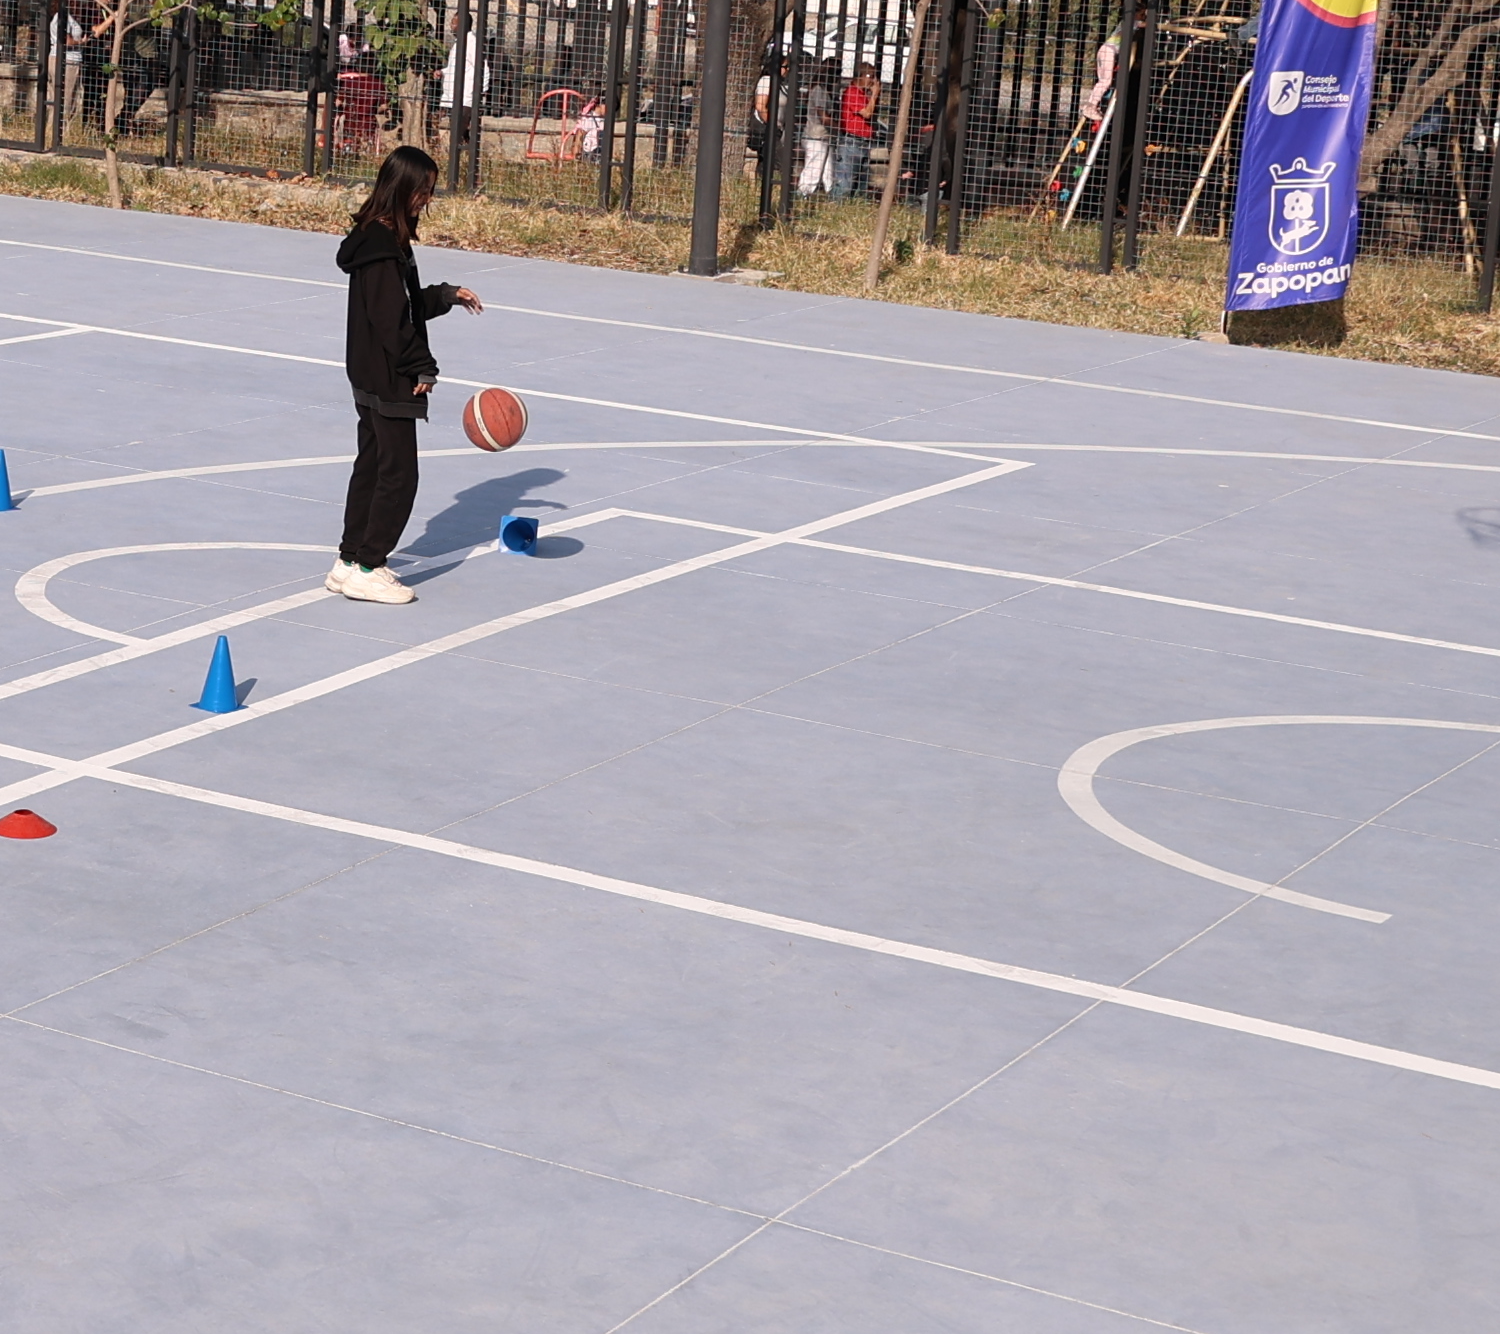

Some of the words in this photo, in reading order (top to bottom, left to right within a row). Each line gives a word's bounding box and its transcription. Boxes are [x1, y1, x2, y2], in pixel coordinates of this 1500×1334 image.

[1305, 75, 1337, 86] Consejo
[1303, 85, 1340, 94] Municipal
[1302, 95, 1314, 103] del
[1315, 94, 1349, 104] Deporte
[1257, 260, 1316, 273] Gobierno
[1318, 257, 1333, 267] de
[1236, 264, 1350, 299] Zapopan
